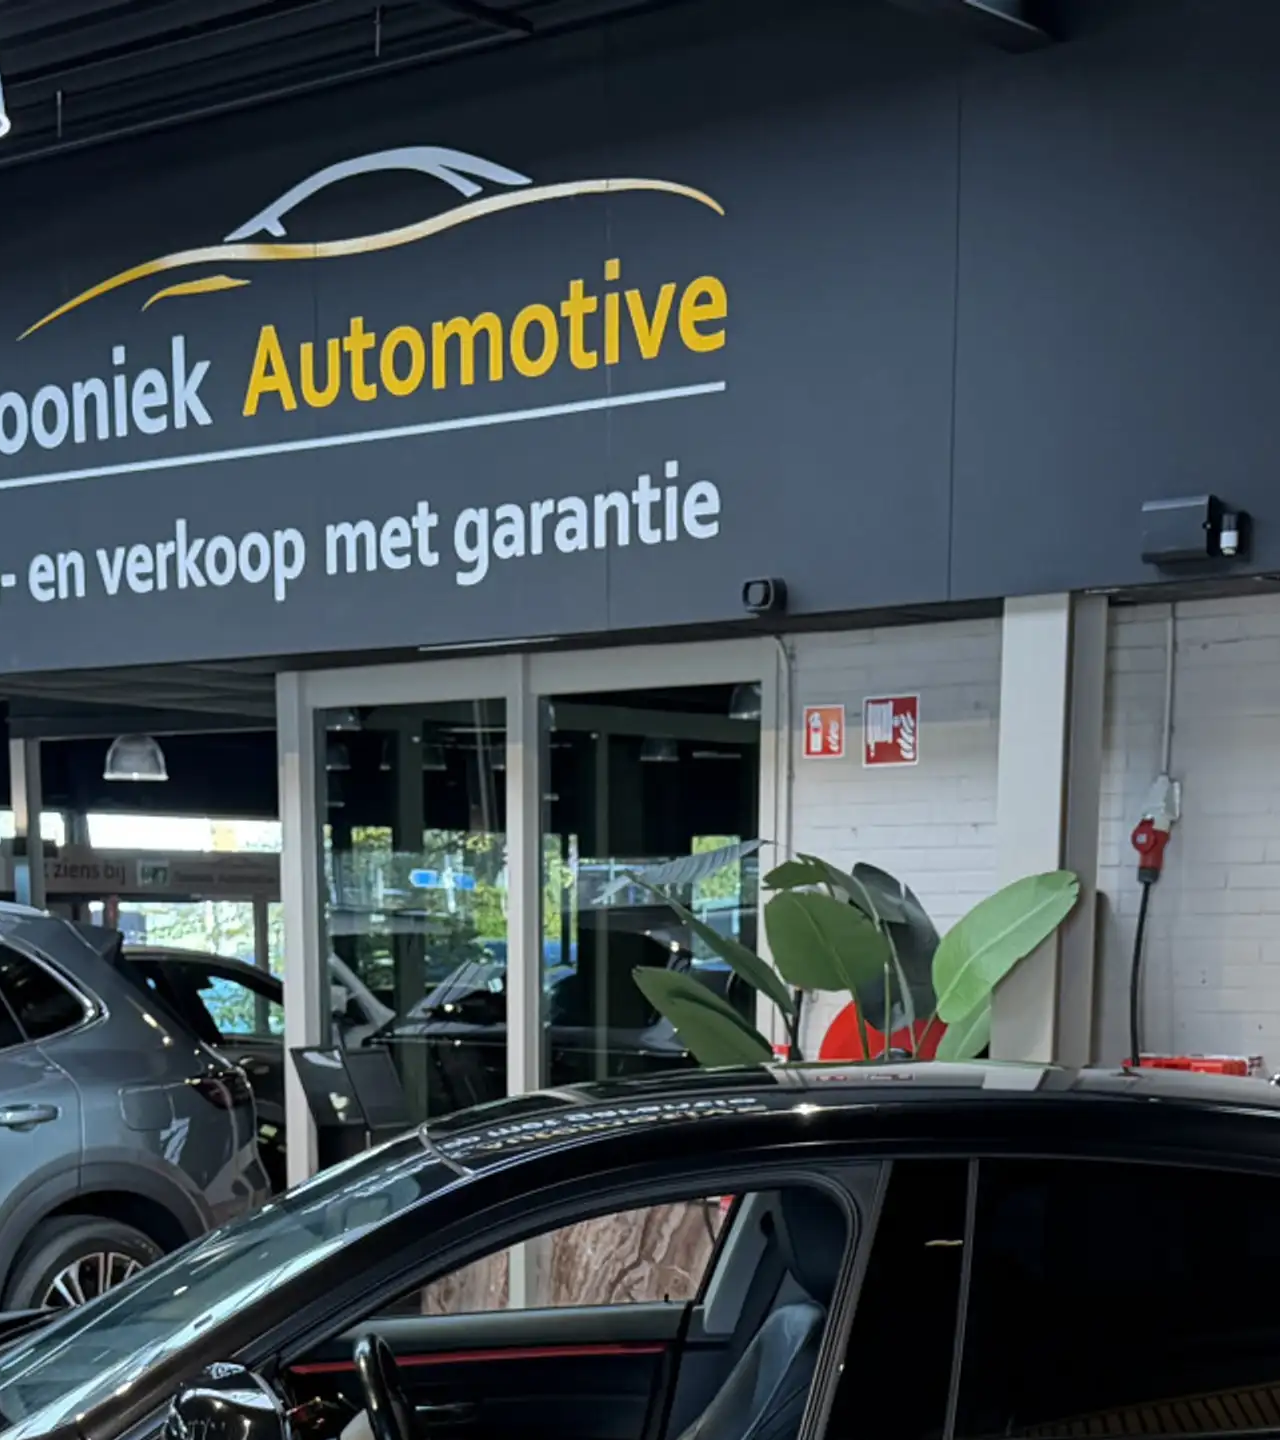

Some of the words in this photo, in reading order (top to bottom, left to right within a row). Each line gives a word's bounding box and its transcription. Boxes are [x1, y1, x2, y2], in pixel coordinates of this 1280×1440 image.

[242, 258, 728, 417] Automotive
[27, 551, 86, 603] en
[95, 517, 307, 603] verkoop
[325, 500, 440, 576] met
[453, 459, 721, 587] garantie
[53, 859, 100, 880] ziens
